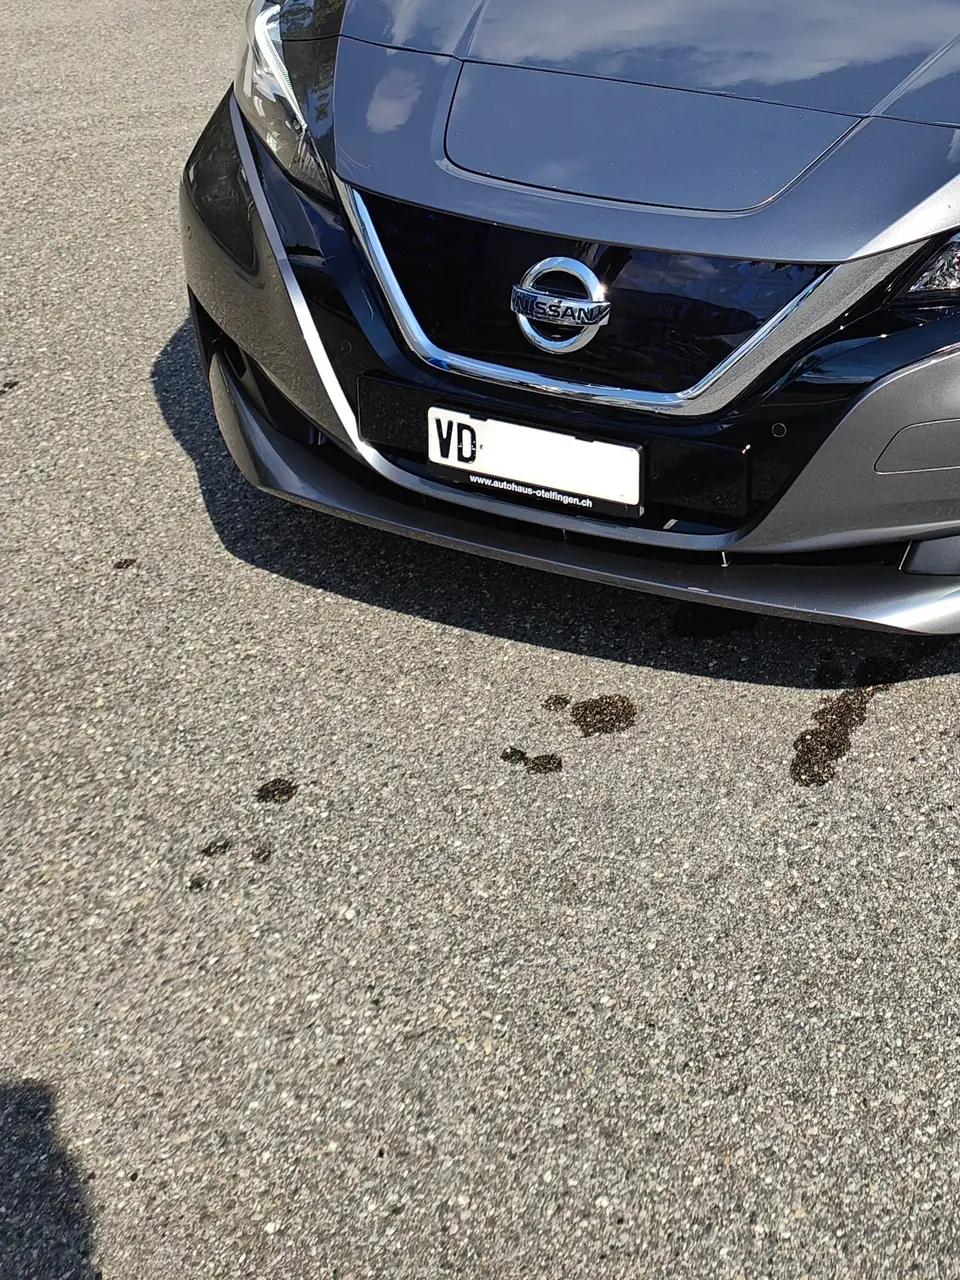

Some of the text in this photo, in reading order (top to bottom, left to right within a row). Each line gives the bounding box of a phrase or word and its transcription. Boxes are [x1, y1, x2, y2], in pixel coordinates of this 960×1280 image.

[513, 291, 595, 324] NISSAN
[435, 418, 477, 465] VD
[469, 474, 593, 508] www.autohaus-otelfingen.ch
